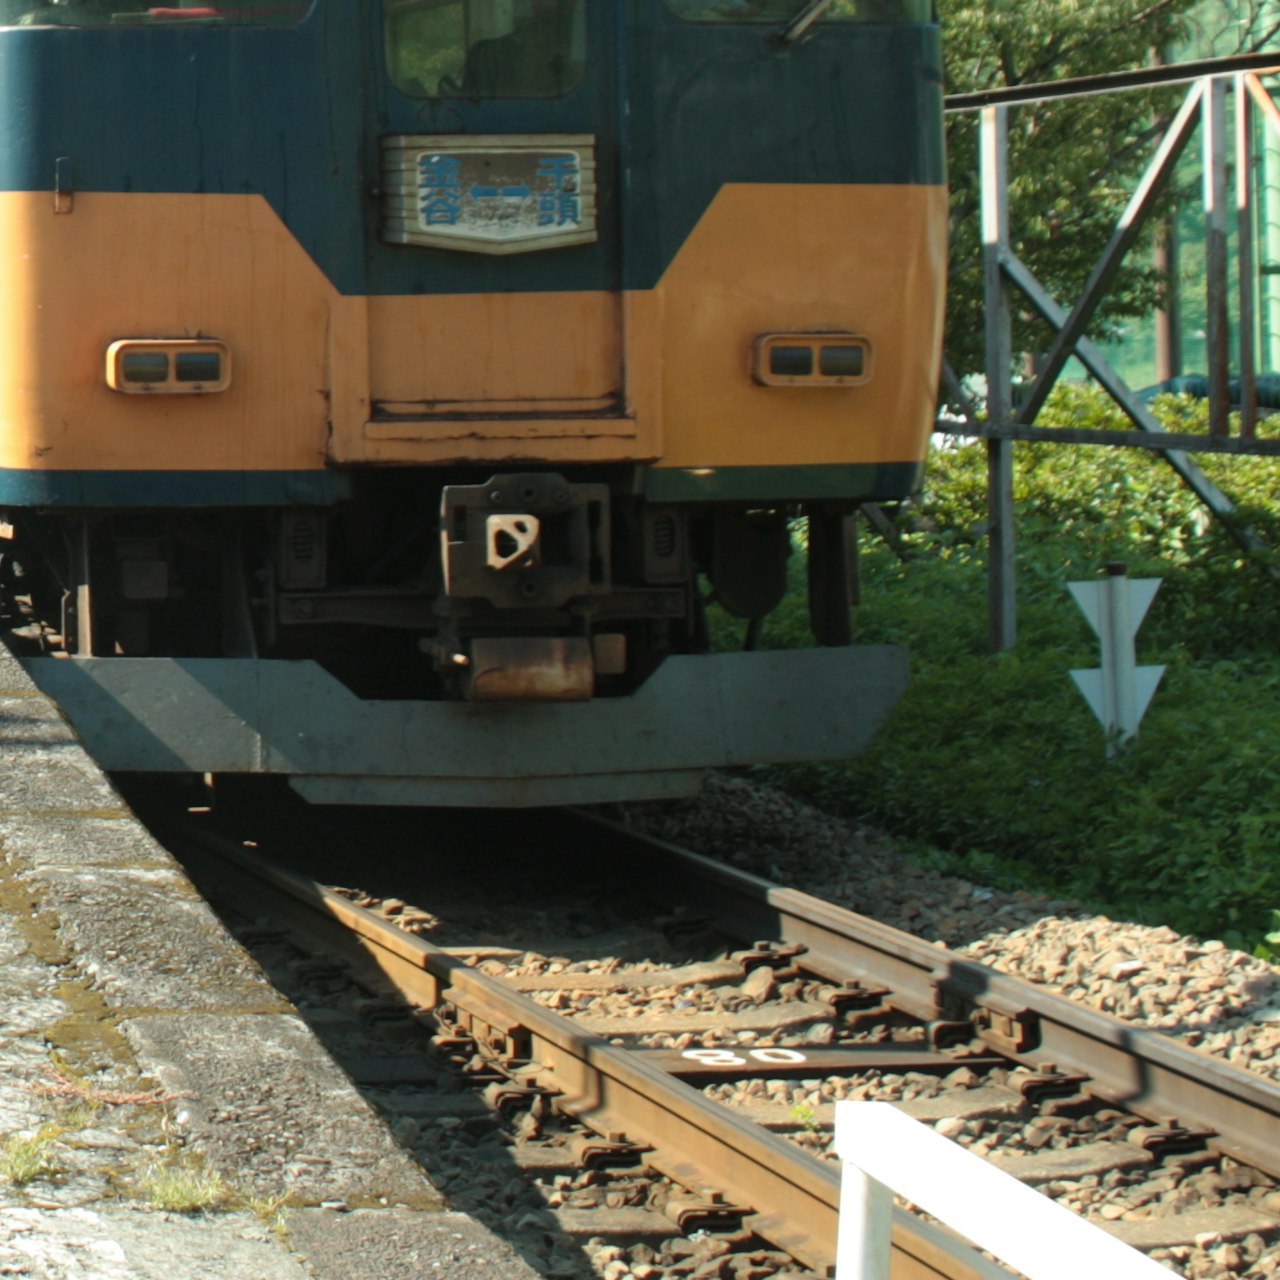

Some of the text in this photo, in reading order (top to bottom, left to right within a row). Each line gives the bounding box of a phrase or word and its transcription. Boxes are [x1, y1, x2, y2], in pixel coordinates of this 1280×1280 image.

[418, 154, 462, 225] 金谷
[537, 155, 579, 226] 千頭
[682, 1048, 806, 1065] 80
